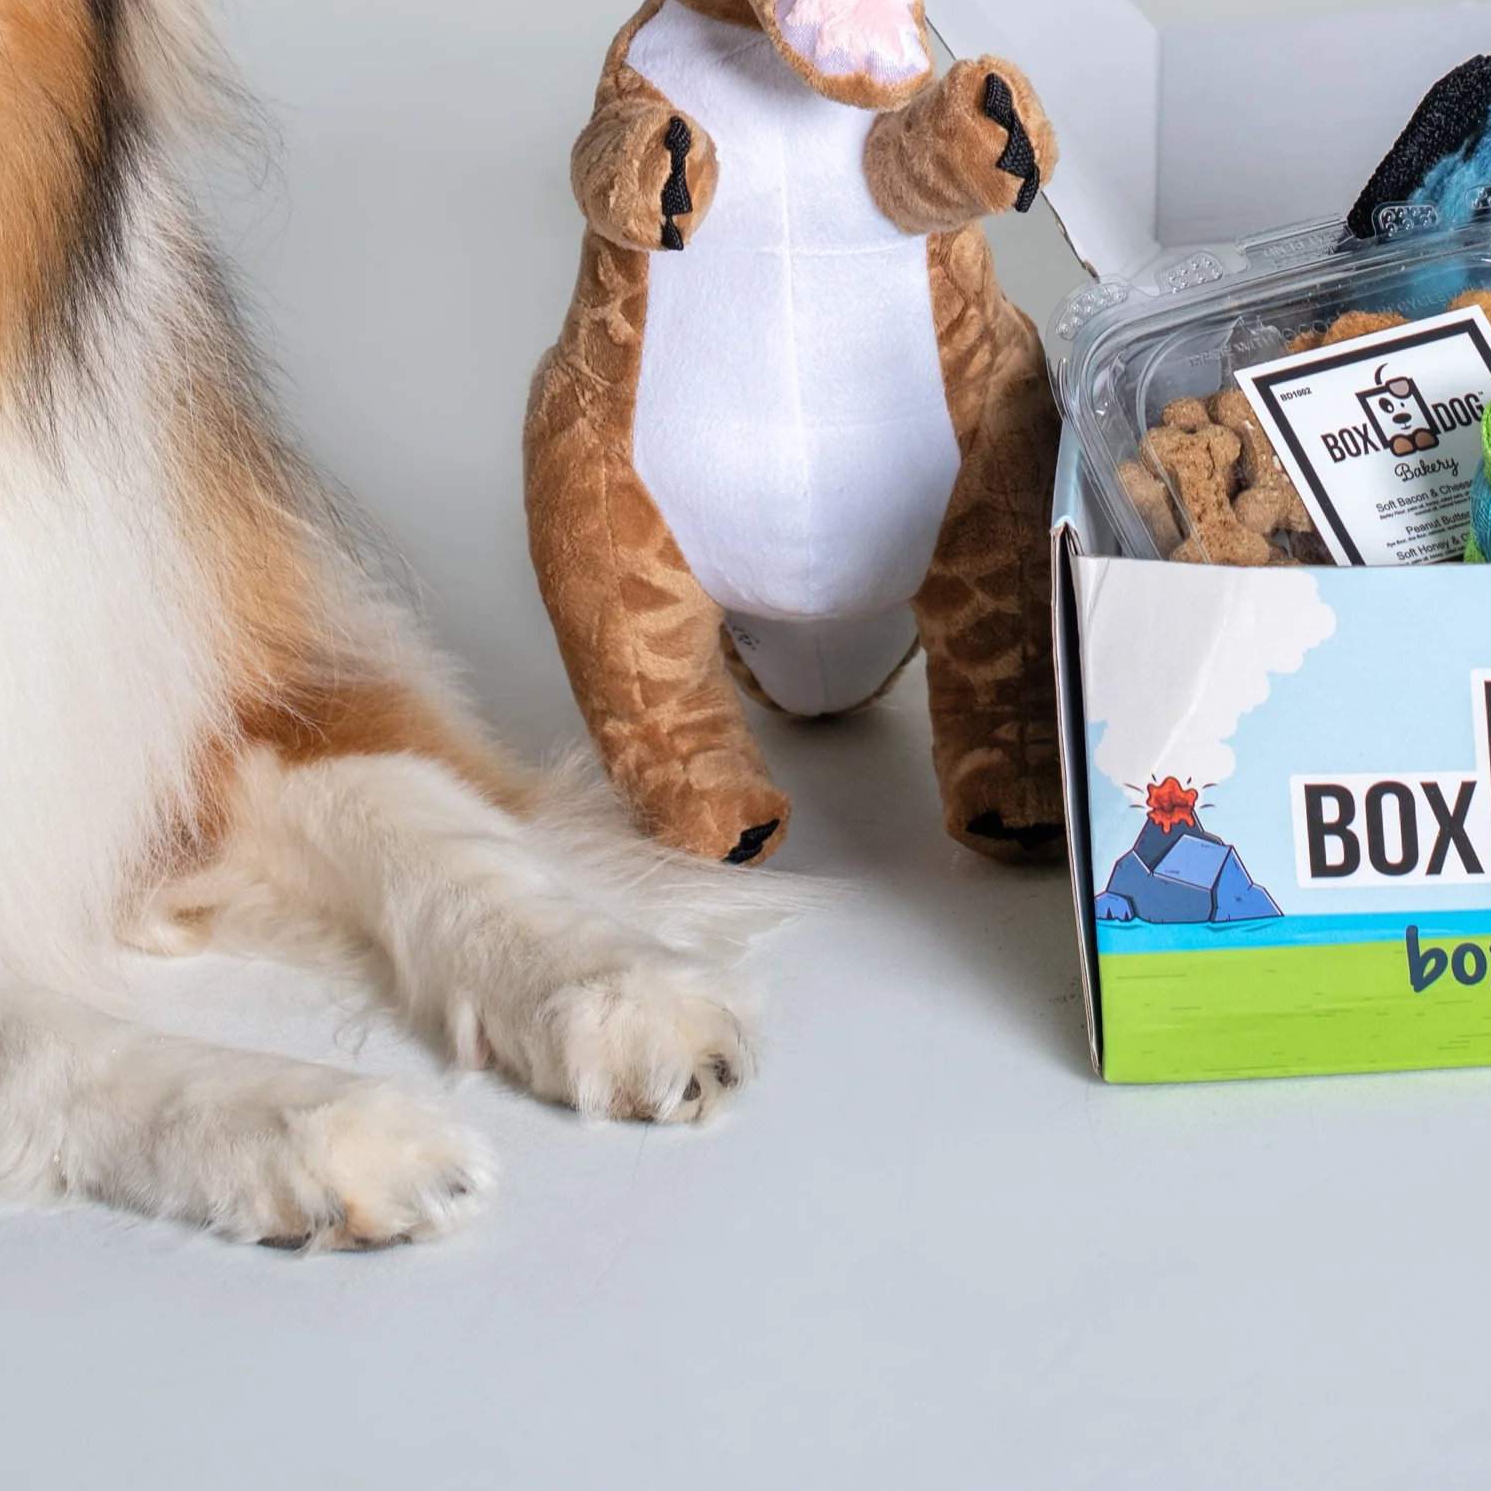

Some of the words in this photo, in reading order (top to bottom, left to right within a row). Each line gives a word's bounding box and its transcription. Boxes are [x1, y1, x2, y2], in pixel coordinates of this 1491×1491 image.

[1280, 387, 1312, 402] BD1002
[1321, 423, 1381, 463] BOX
[1431, 394, 1484, 432] DOG
[1394, 457, 1459, 482] Bakery
[1376, 500, 1396, 513] Soft
[1397, 493, 1429, 507] Bacon
[1430, 488, 1438, 497] &
[1439, 481, 1472, 495] Chees
[1405, 519, 1441, 535] Peanut
[1441, 511, 1471, 526] Butter
[1396, 547, 1417, 561] Soft
[1417, 538, 1450, 555] Honey
[1451, 535, 1460, 545] &
[1303, 779, 1485, 879] BOX
